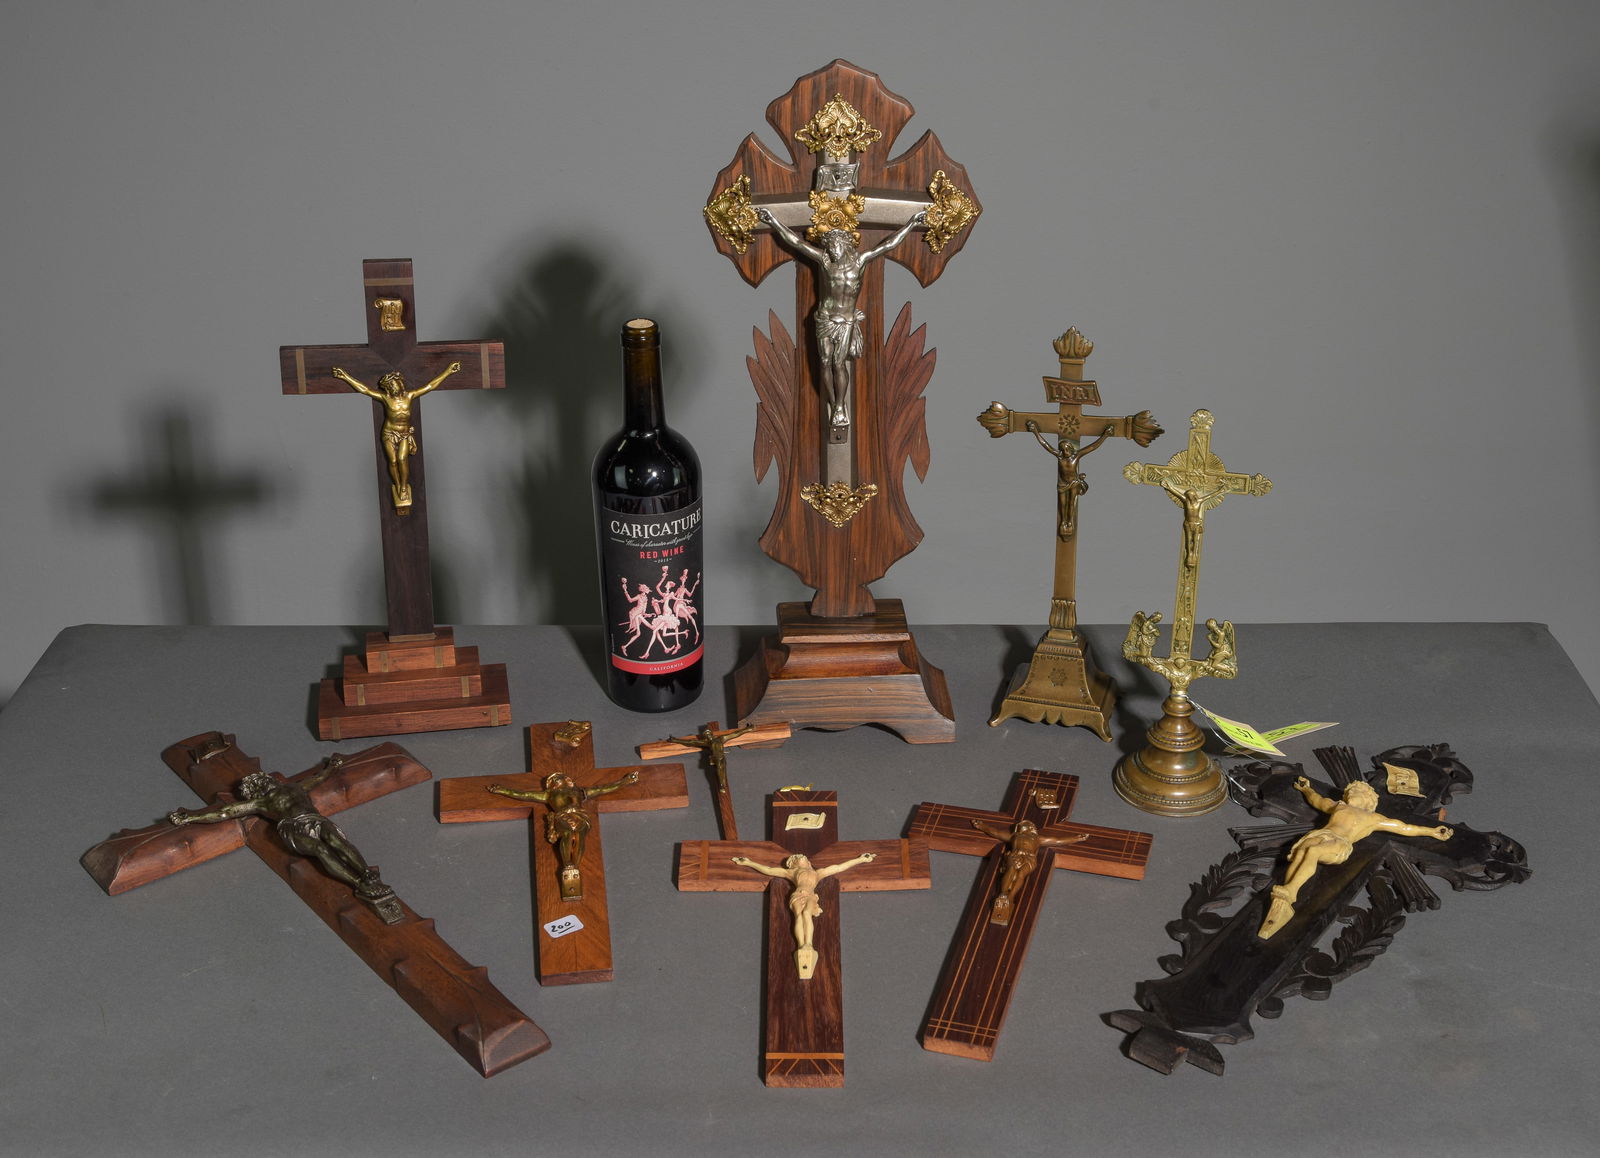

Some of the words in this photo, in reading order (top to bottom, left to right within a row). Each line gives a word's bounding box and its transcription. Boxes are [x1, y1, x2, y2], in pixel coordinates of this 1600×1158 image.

[1049, 383, 1096, 401] INRI
[610, 508, 702, 539] CARICATURE
[640, 551, 659, 559] RED
[661, 545, 685, 557] WINE
[649, 662, 684, 671] CALIFORNIA
